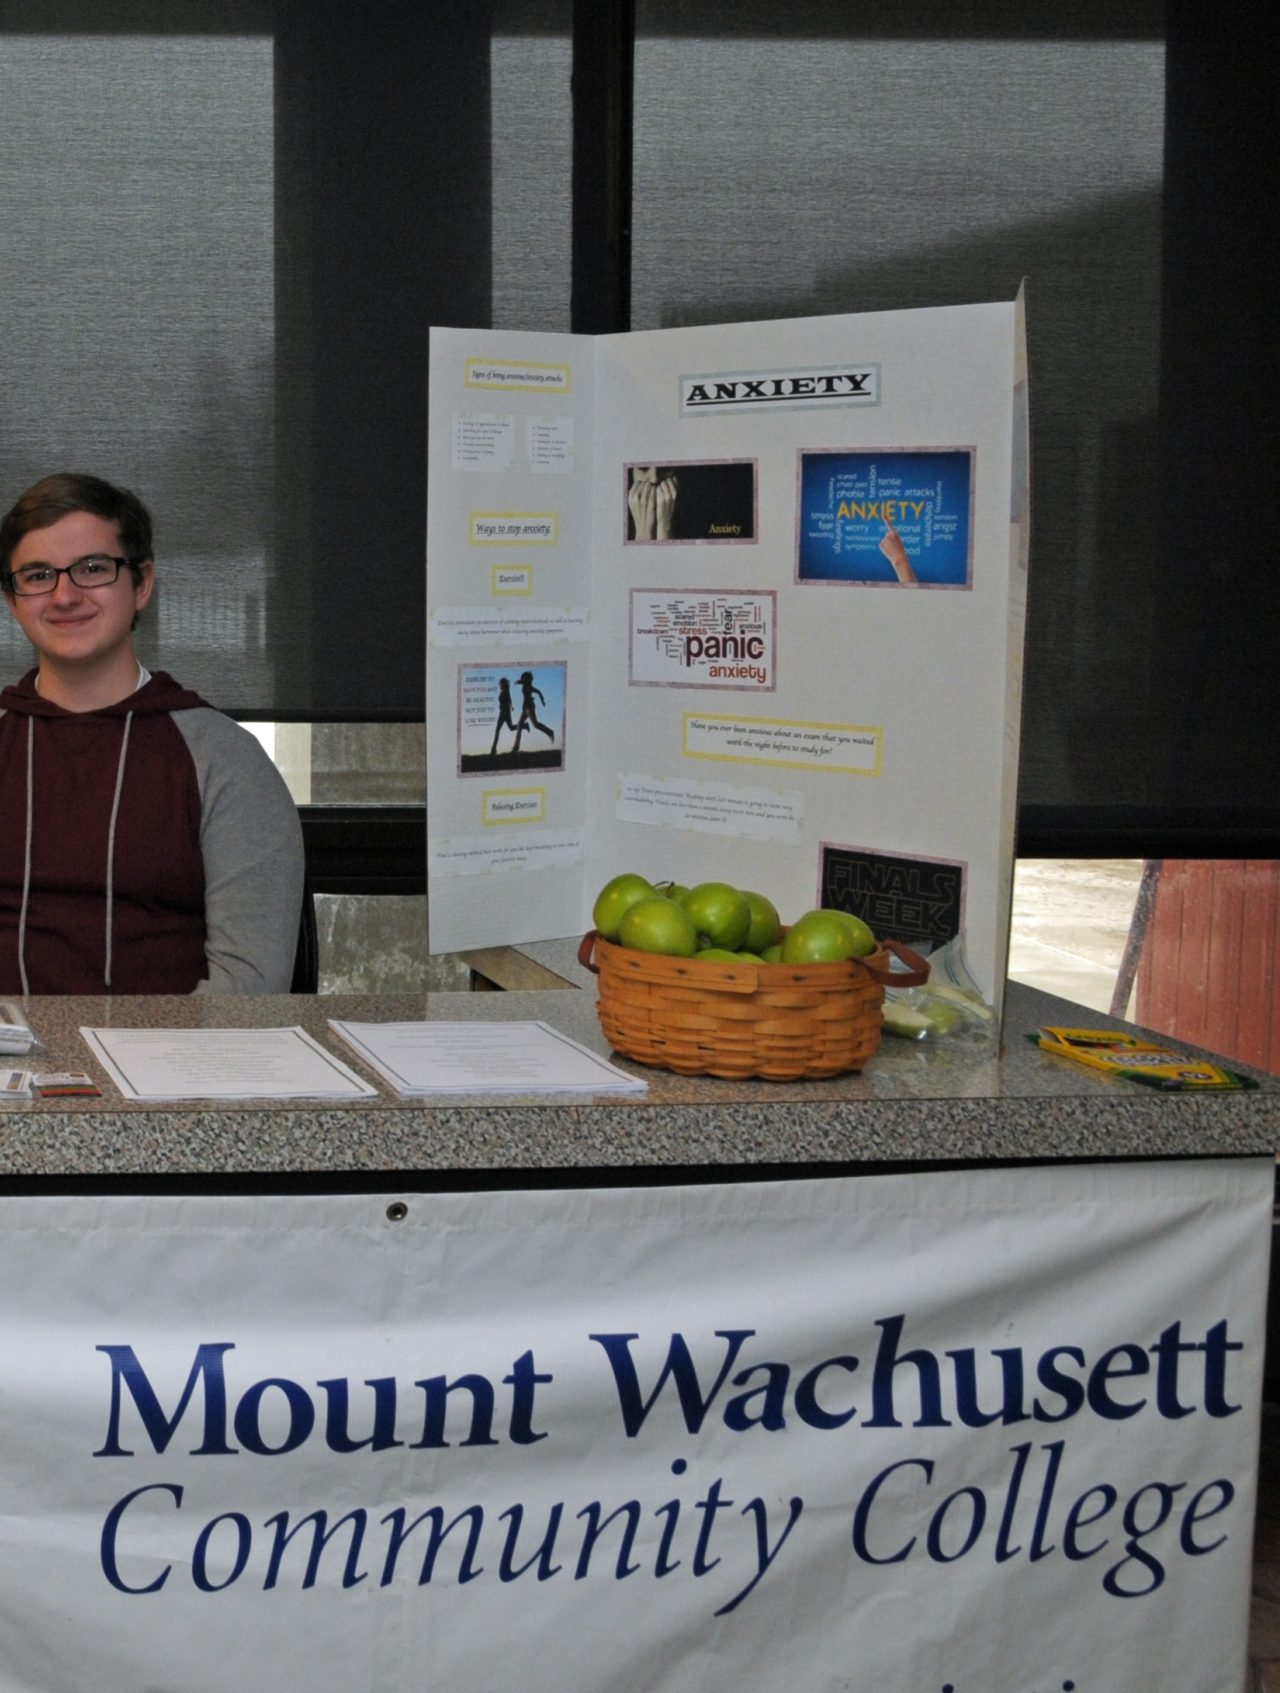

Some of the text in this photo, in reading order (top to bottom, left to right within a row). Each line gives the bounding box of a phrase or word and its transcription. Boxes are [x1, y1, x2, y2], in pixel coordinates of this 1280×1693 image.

[686, 373, 872, 402] ANXIETY
[836, 489, 864, 499] phobia
[879, 487, 935, 498] panic attacks
[837, 500, 925, 520] ANXIETY
[476, 524, 495, 537] Ways
[498, 524, 506, 533] to
[507, 523, 522, 537] stop
[709, 523, 742, 536] Anxiety
[679, 626, 708, 635] stress
[723, 608, 733, 635] fear
[686, 629, 765, 667] panic
[709, 663, 766, 684] anxiety
[828, 857, 956, 904] FINALS
[829, 887, 951, 937] WEEK
[92, 1313, 1244, 1458] Mount Wachusett
[100, 1440, 1235, 1618] Community College
